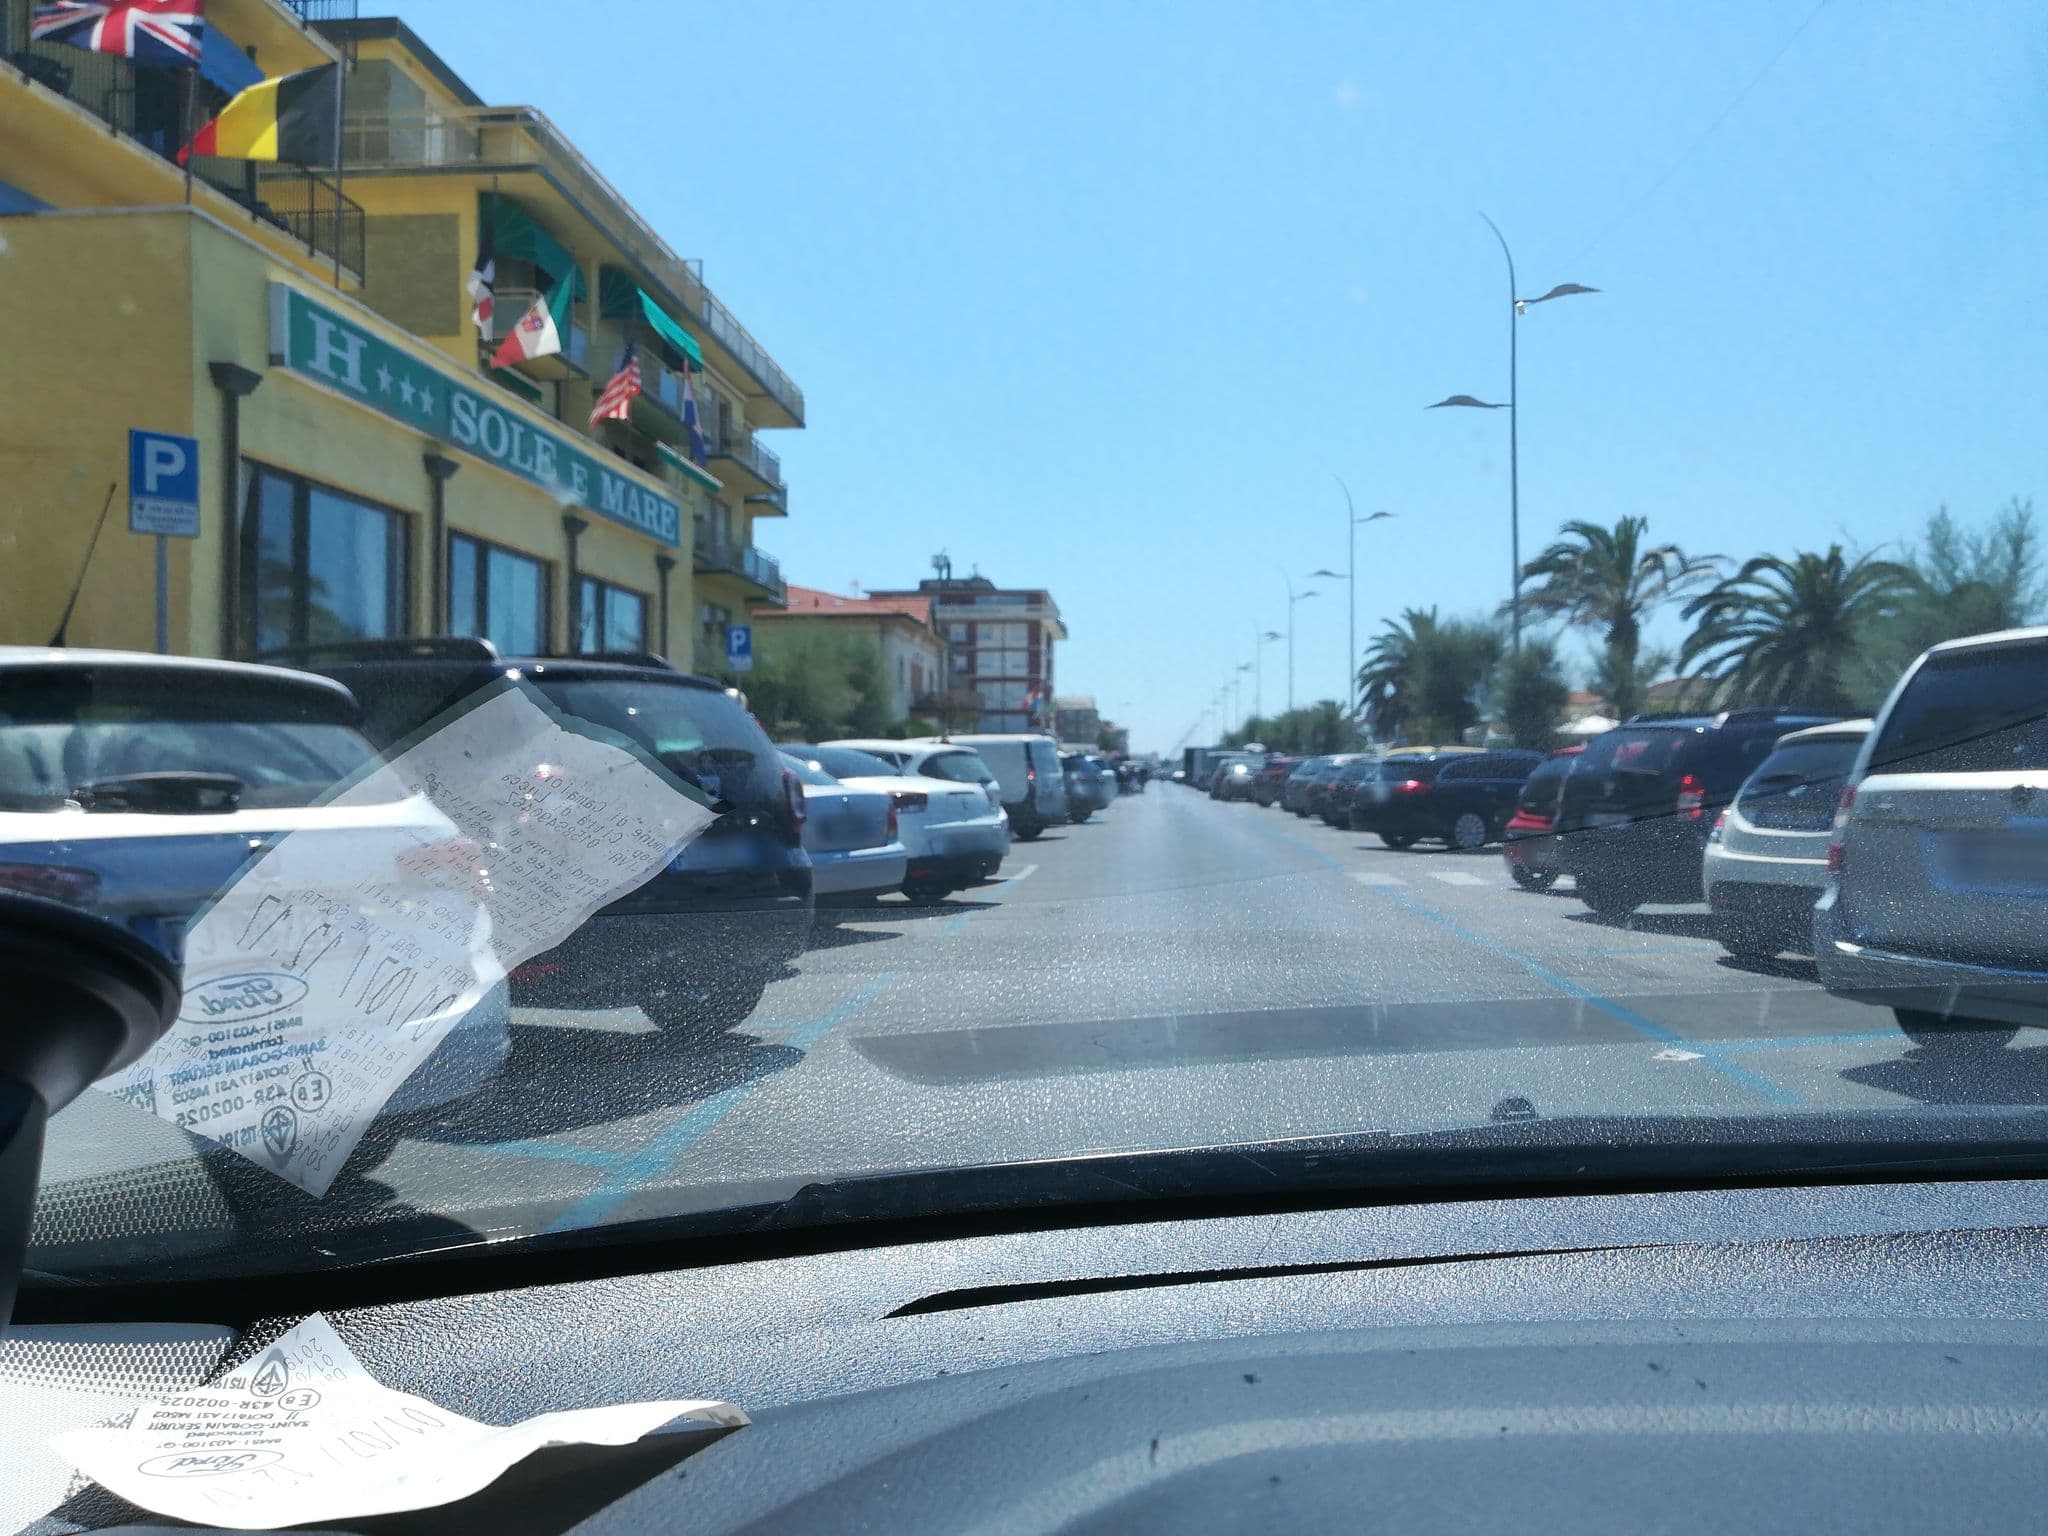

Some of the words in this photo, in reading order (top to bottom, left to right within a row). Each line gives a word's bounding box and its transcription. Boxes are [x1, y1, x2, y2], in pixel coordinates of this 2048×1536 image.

[306, 311, 369, 394] H
[450, 390, 558, 482] SOLE
[570, 465, 589, 499] E
[598, 472, 677, 538] MARE
[144, 438, 187, 493] P
[730, 629, 747, 653] P
[145, 1422, 201, 1430] SEKURIT
[205, 1419, 310, 1430] SAINT-GOBAIN
[165, 1453, 256, 1473] Ford
